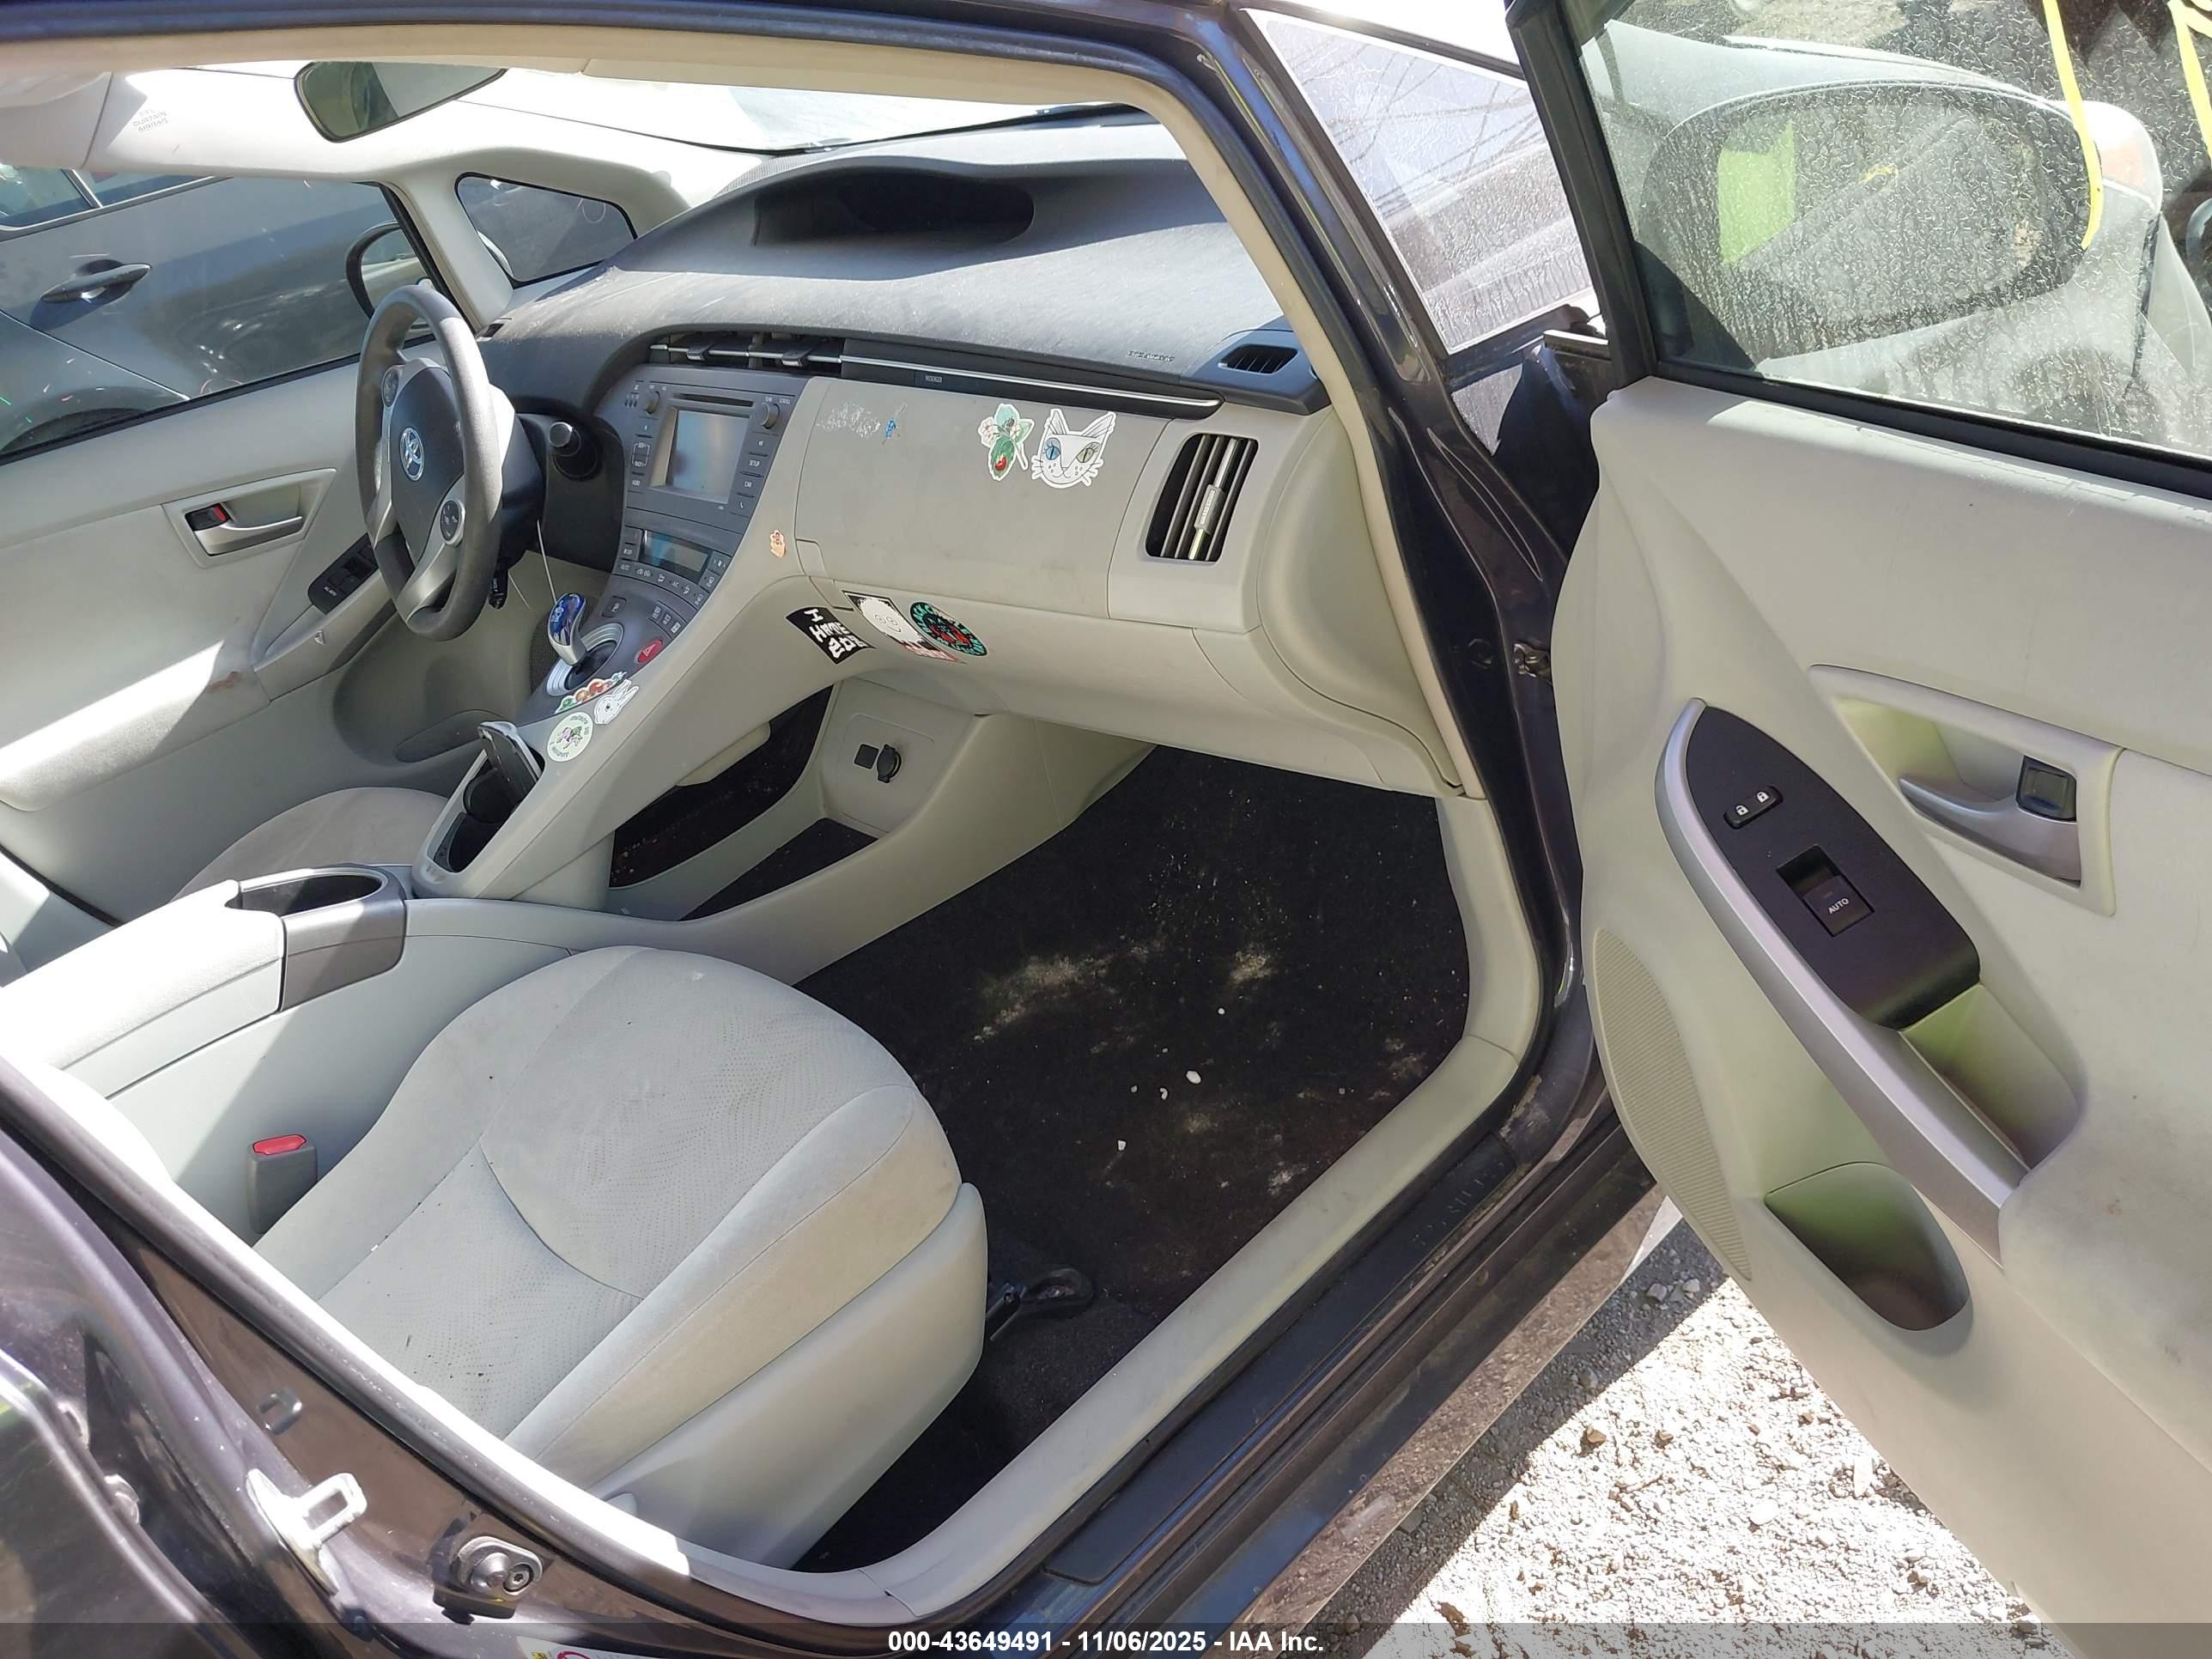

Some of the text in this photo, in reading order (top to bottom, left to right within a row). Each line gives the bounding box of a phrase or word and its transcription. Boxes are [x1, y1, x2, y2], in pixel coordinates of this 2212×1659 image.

[804, 608, 824, 623] I
[809, 621, 851, 643] HATE
[1828, 897, 1850, 915] AUTO
